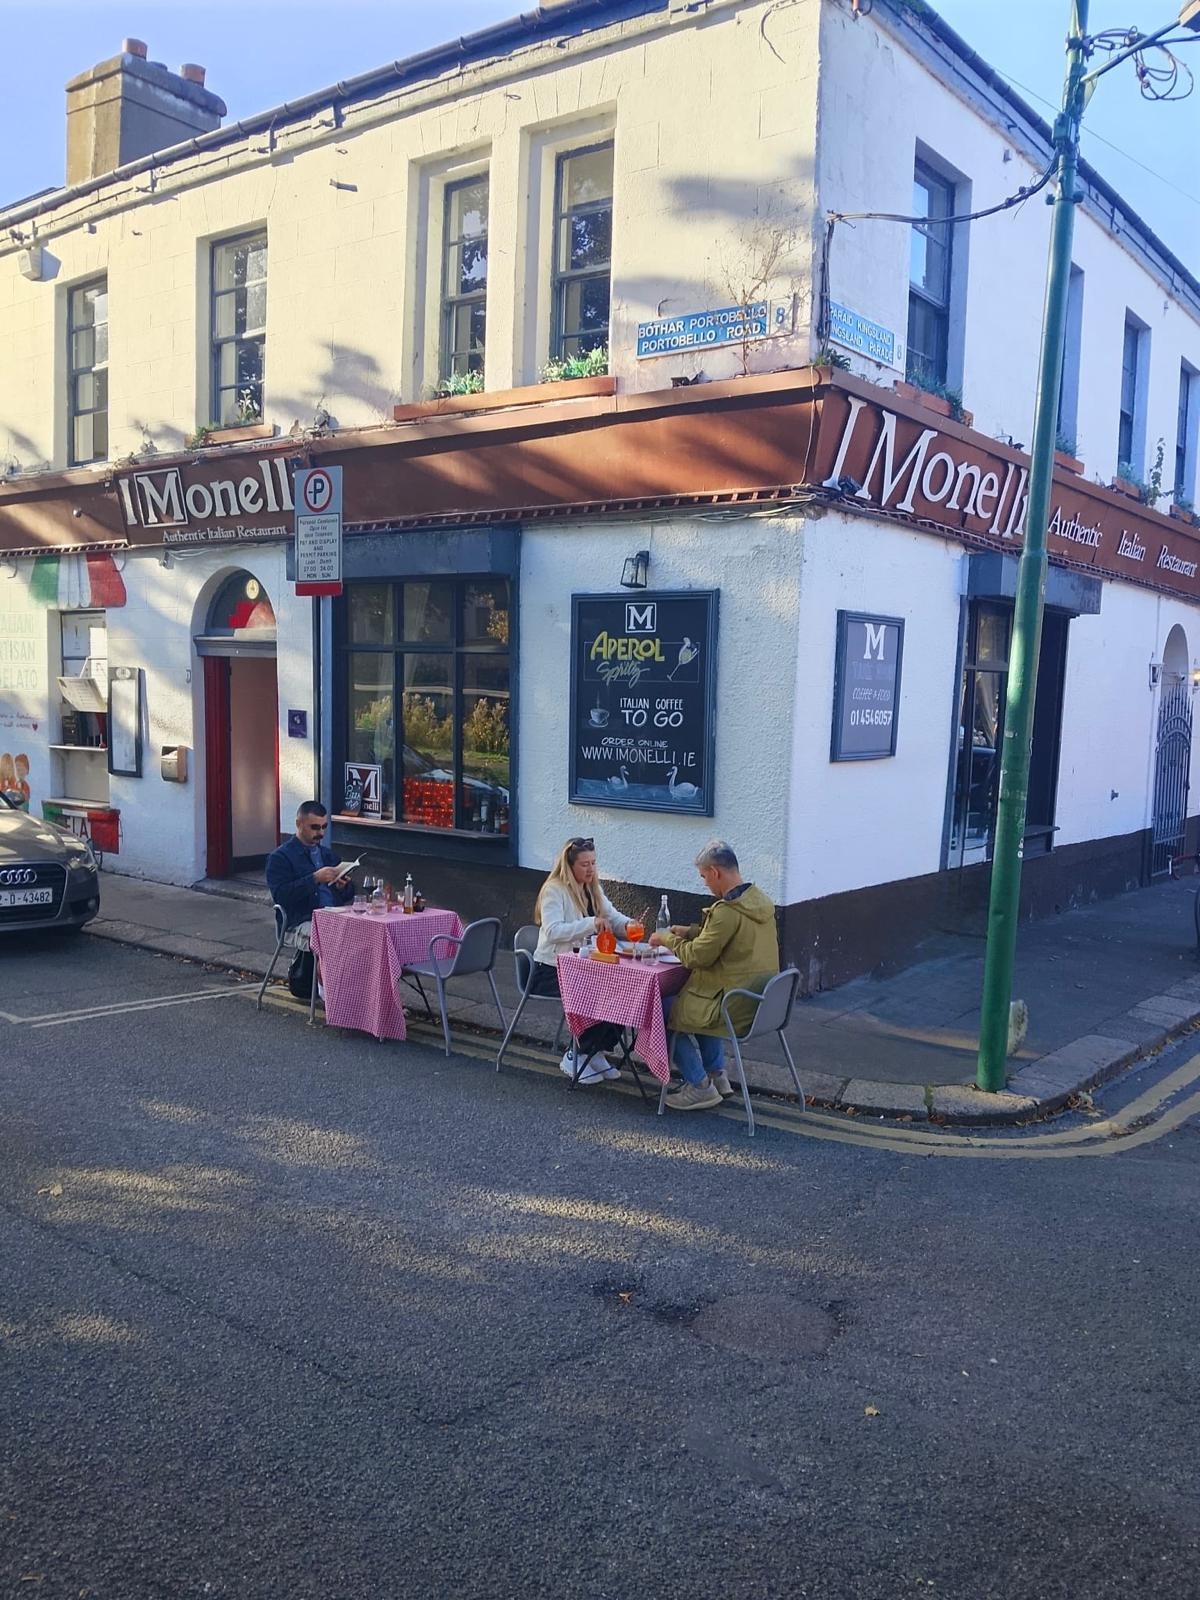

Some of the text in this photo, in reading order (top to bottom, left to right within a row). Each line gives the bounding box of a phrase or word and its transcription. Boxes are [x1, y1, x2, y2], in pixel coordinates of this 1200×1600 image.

[638, 305, 767, 339] BÓTHAR PORTOBELLO
[775, 306, 785, 325] 8
[642, 322, 761, 353] PORTOBELLO ROAD
[831, 321, 862, 347] INGSLAND
[822, 395, 867, 491] I
[118, 457, 295, 525] I Monell
[162, 525, 288, 542] Authentic Italian Restaurant
[1048, 505, 1198, 578] Authentic Italian Restaurant
[628, 605, 653, 630] M
[590, 631, 665, 662] APEROL
[863, 623, 886, 660] M
[0, 668, 38, 689] ELATO
[596, 660, 650, 688] Spritz
[620, 697, 649, 709] ITALIAN
[621, 709, 683, 727] TO GO
[601, 737, 668, 748] ORDER ONLINE
[363, 801, 379, 811] nelli
